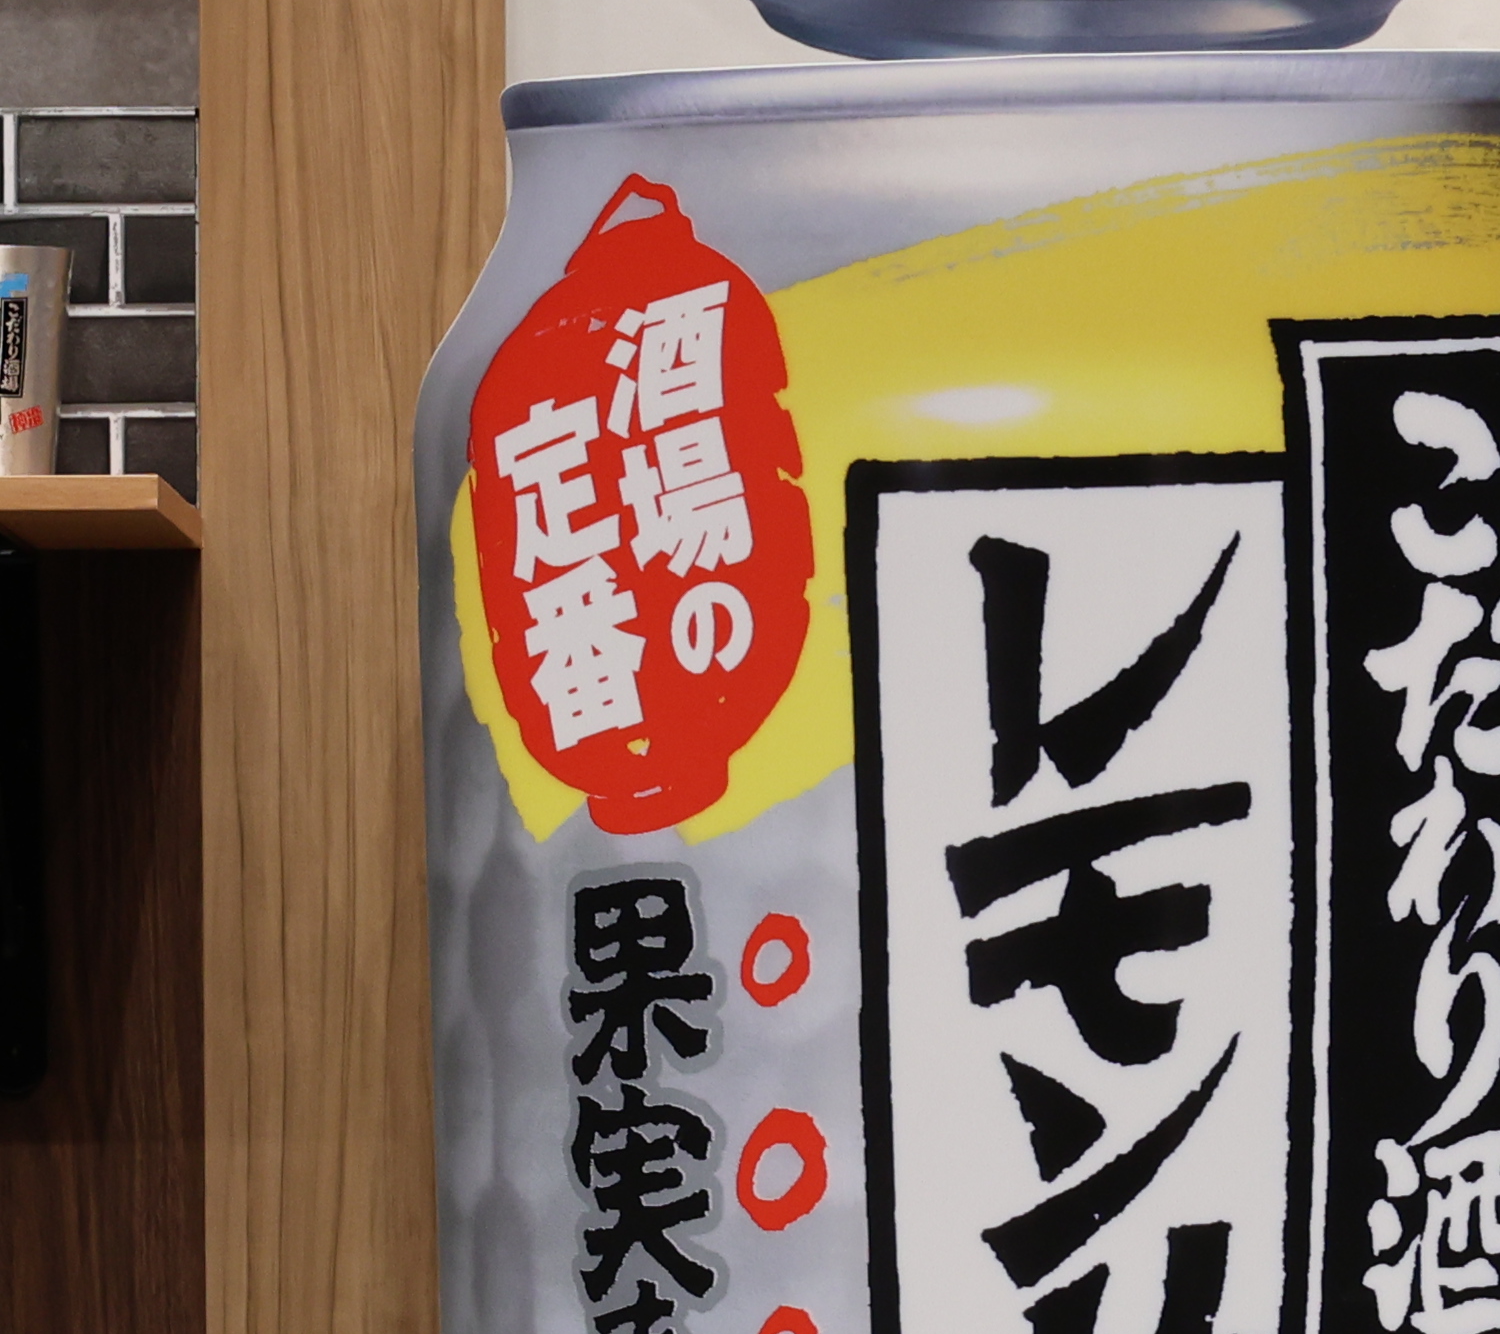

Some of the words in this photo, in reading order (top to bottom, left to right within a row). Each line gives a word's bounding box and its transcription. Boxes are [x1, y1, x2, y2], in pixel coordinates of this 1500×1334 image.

[493, 393, 648, 753] 定番
[605, 279, 755, 676] 酒場の
